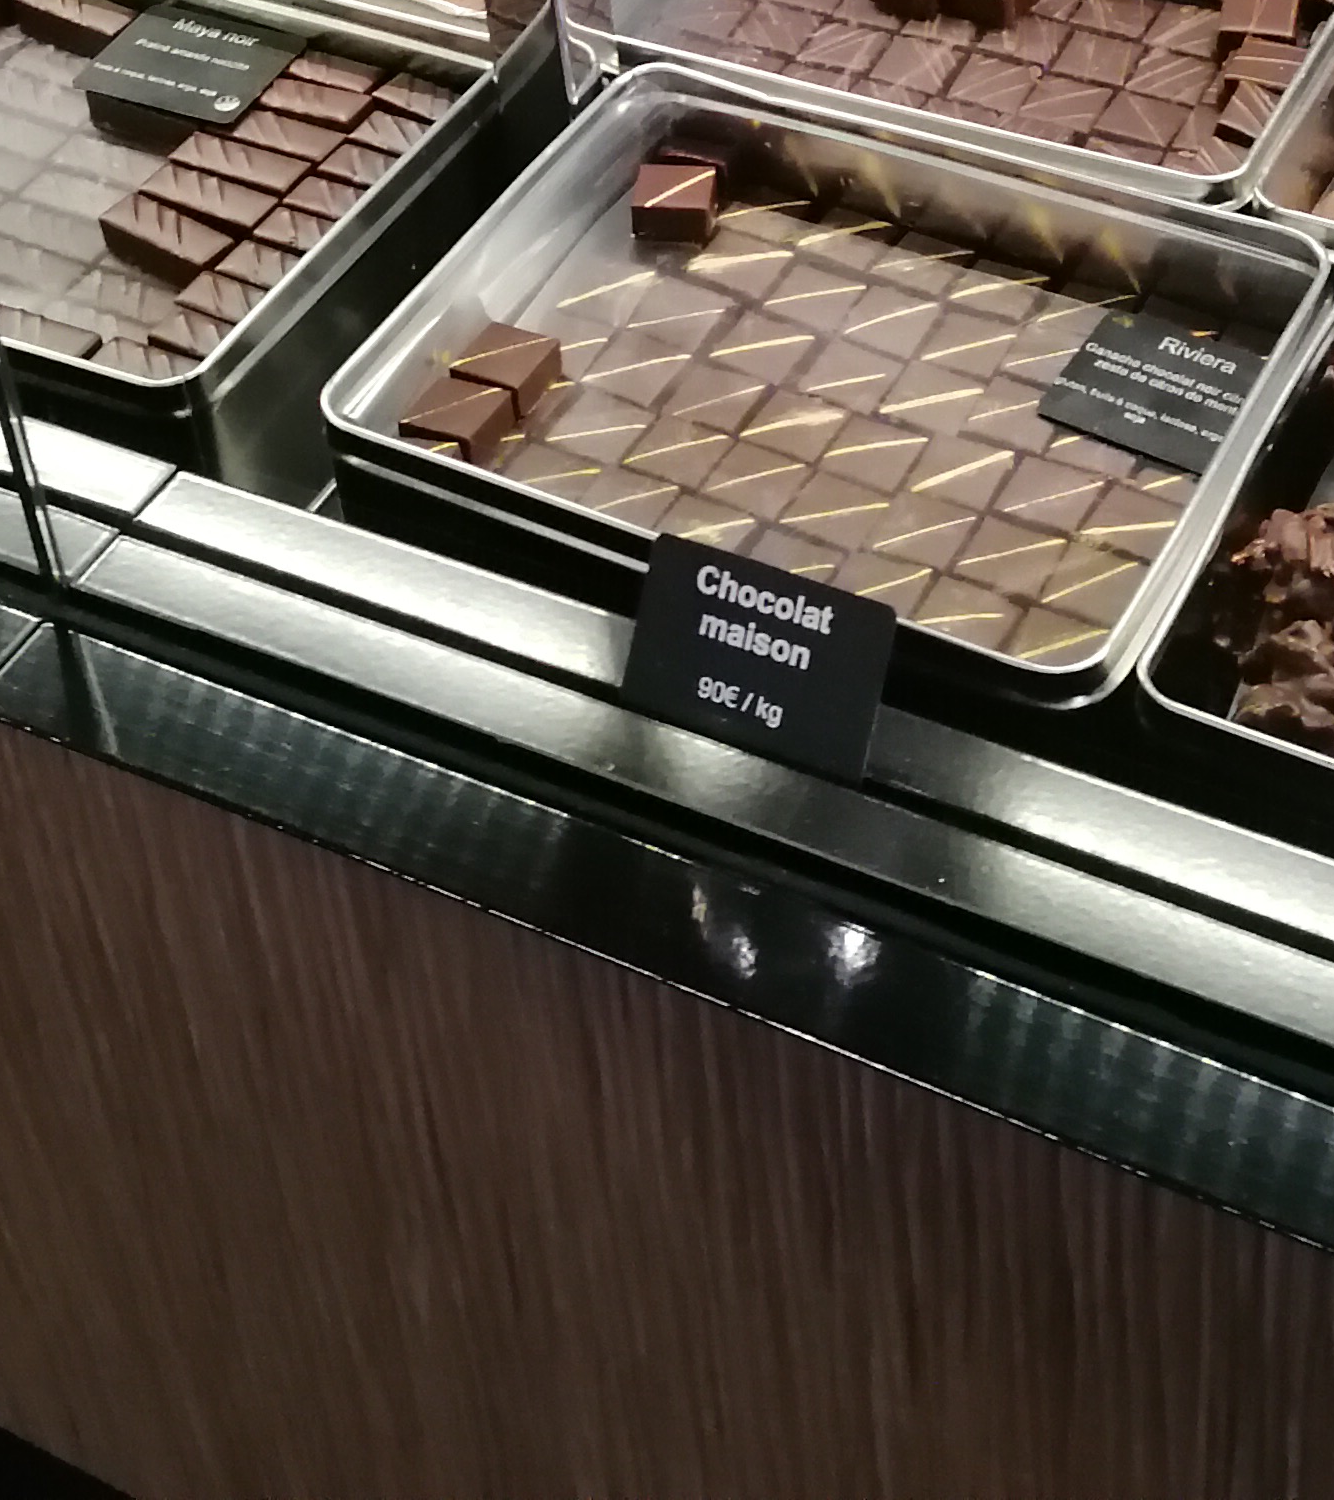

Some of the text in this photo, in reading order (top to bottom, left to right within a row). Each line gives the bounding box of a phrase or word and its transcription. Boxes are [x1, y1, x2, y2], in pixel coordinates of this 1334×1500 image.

[172, 17, 260, 47] Maya noir
[1085, 342, 1141, 368] Ganache
[1142, 362, 1196, 388] chocolat
[1157, 336, 1238, 375] Riviera
[1130, 370, 1147, 383] de
[1148, 378, 1184, 396] citron
[697, 565, 834, 634] Chocolat
[698, 613, 811, 670] maison
[697, 676, 784, 728] 90€ / kg
